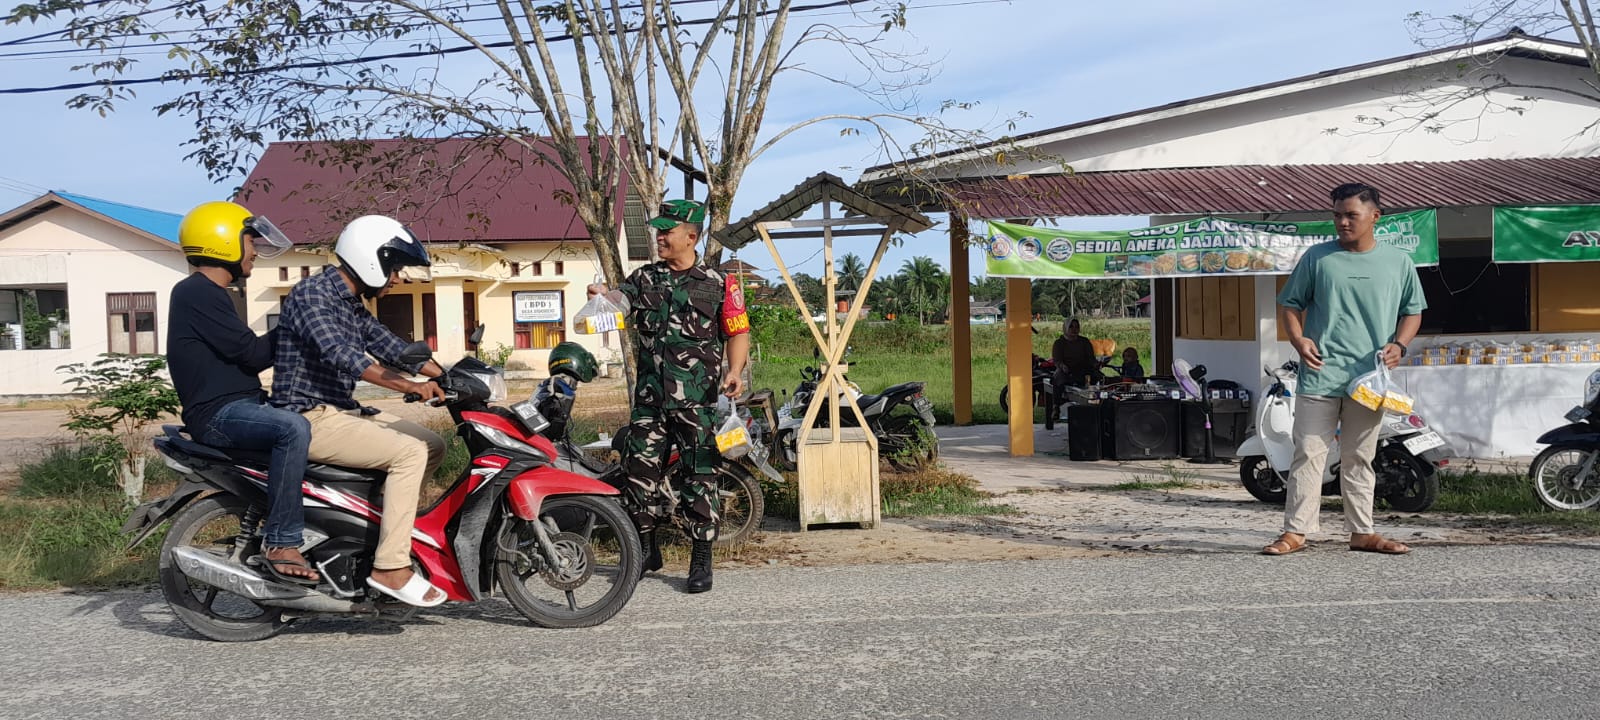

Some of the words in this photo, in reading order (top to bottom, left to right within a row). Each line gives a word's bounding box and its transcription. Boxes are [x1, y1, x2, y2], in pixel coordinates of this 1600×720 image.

[1075, 240, 1122, 253] SEDIA
[1125, 238, 1176, 252] ANEKA
[1180, 235, 1257, 249] JAJANAN
